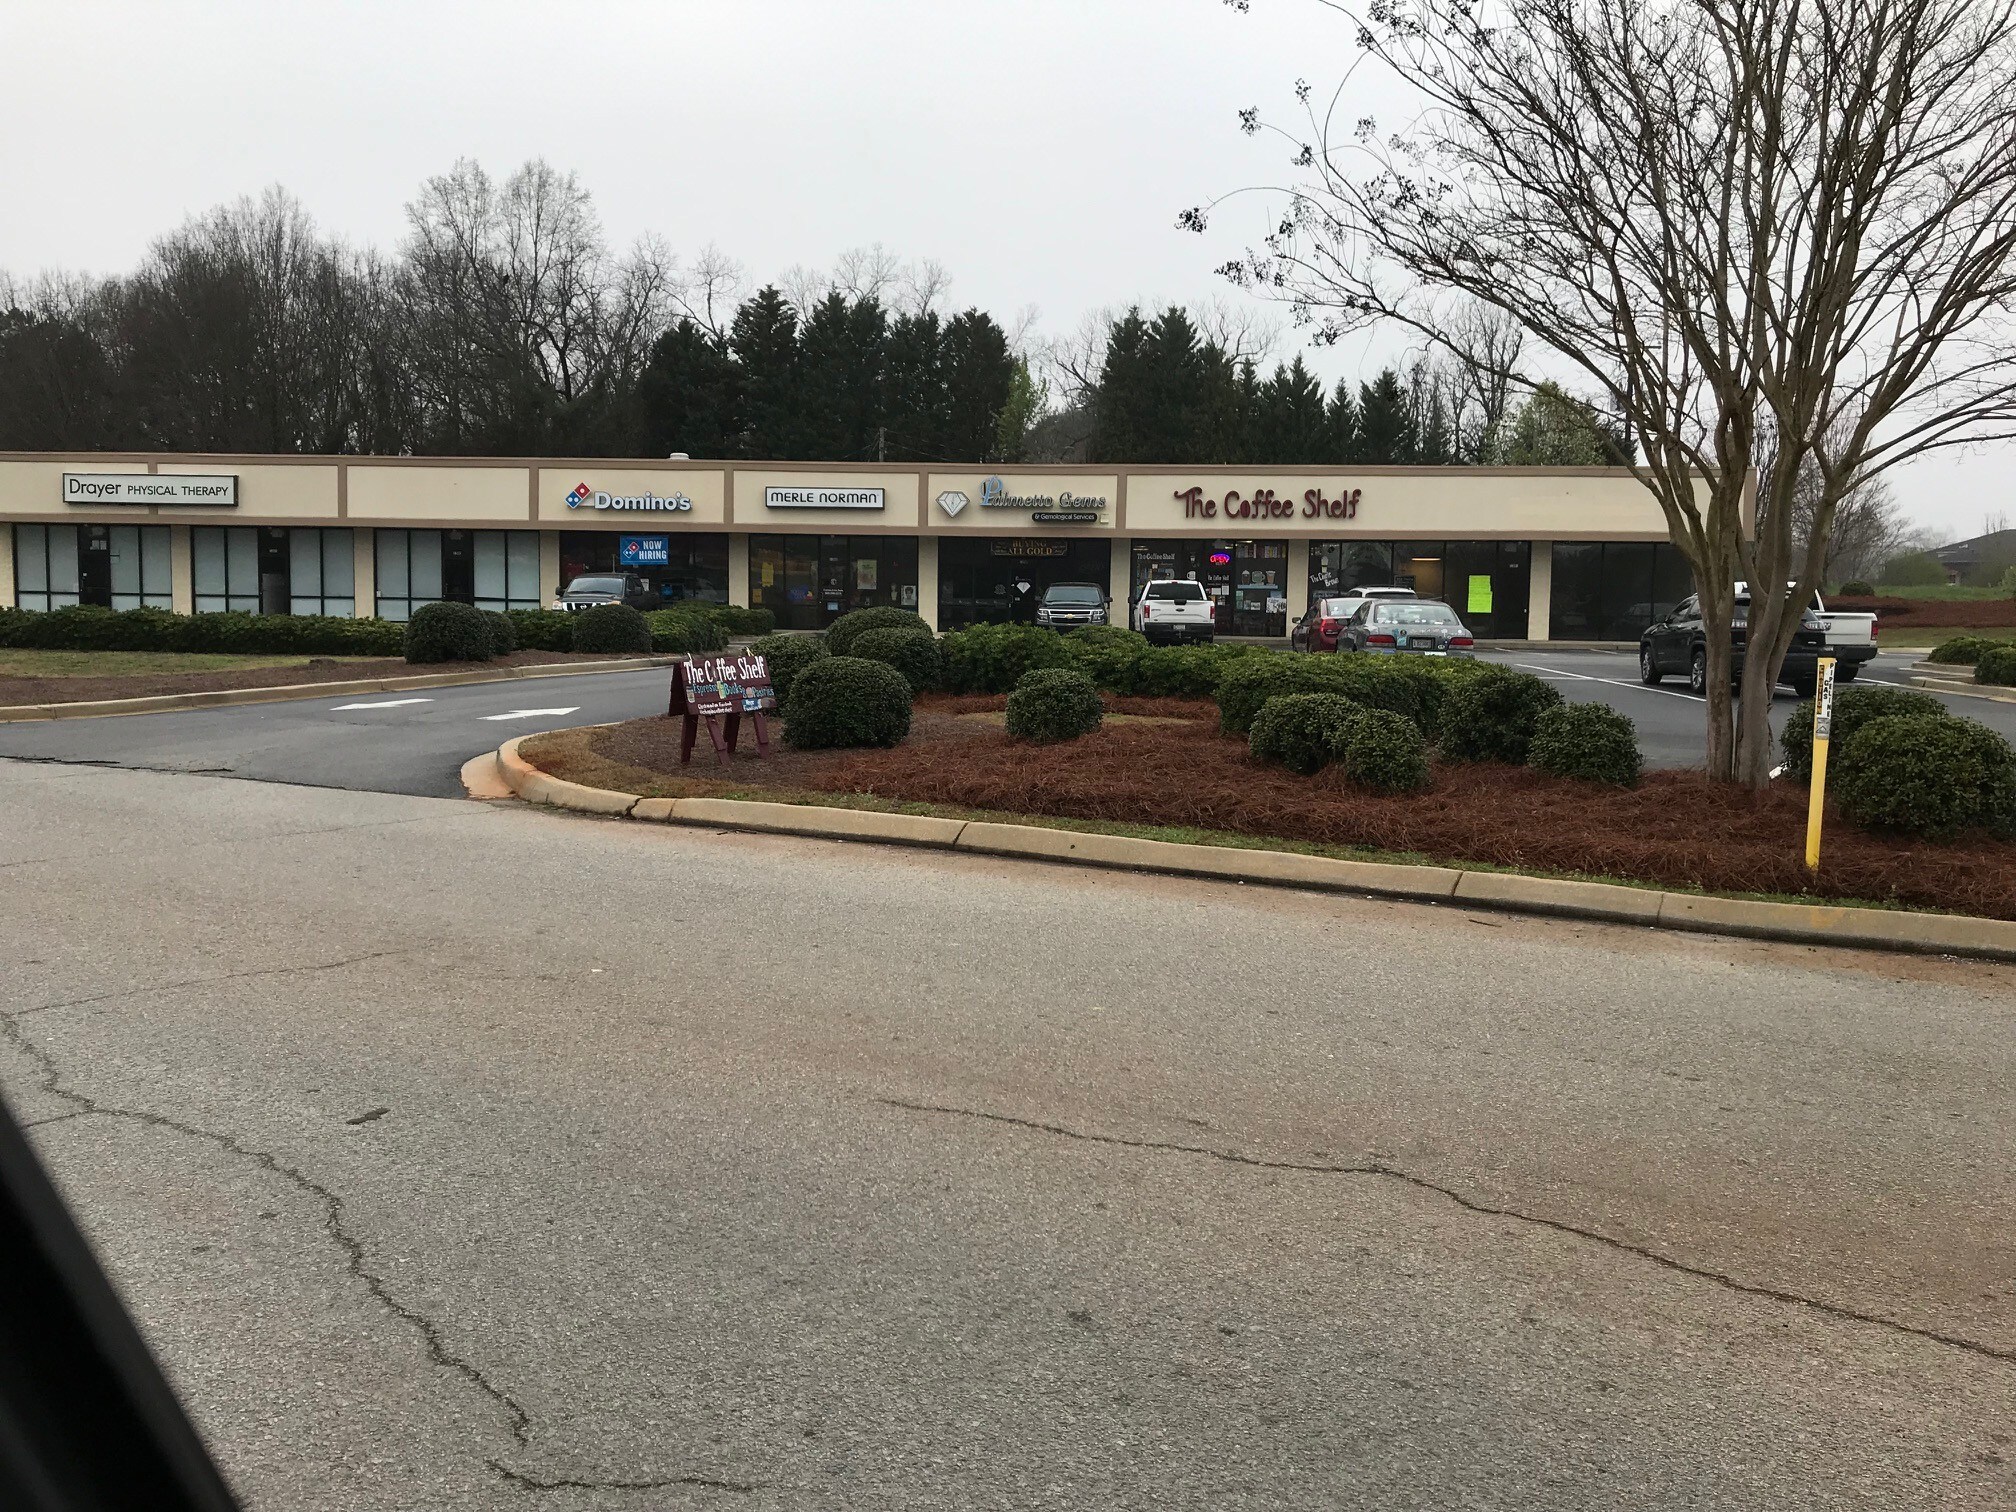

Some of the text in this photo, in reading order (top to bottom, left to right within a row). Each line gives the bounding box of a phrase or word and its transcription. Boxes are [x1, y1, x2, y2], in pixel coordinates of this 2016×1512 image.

[69, 478, 229, 498] Drayer PHYSICAL THERAPY
[980, 475, 1106, 509] Palmetto Gems
[594, 490, 692, 511] Domino's
[770, 492, 877, 503] MERLE NORMAN
[1173, 486, 1362, 519] The Coffee Shelf
[1040, 513, 1073, 521] Gemological
[643, 540, 662, 550] NOW
[1008, 547, 1025, 555] ALL
[1027, 547, 1053, 555] GOLD
[638, 550, 667, 560] HIRING
[684, 659, 704, 684] The
[738, 656, 765, 680] Shelf
